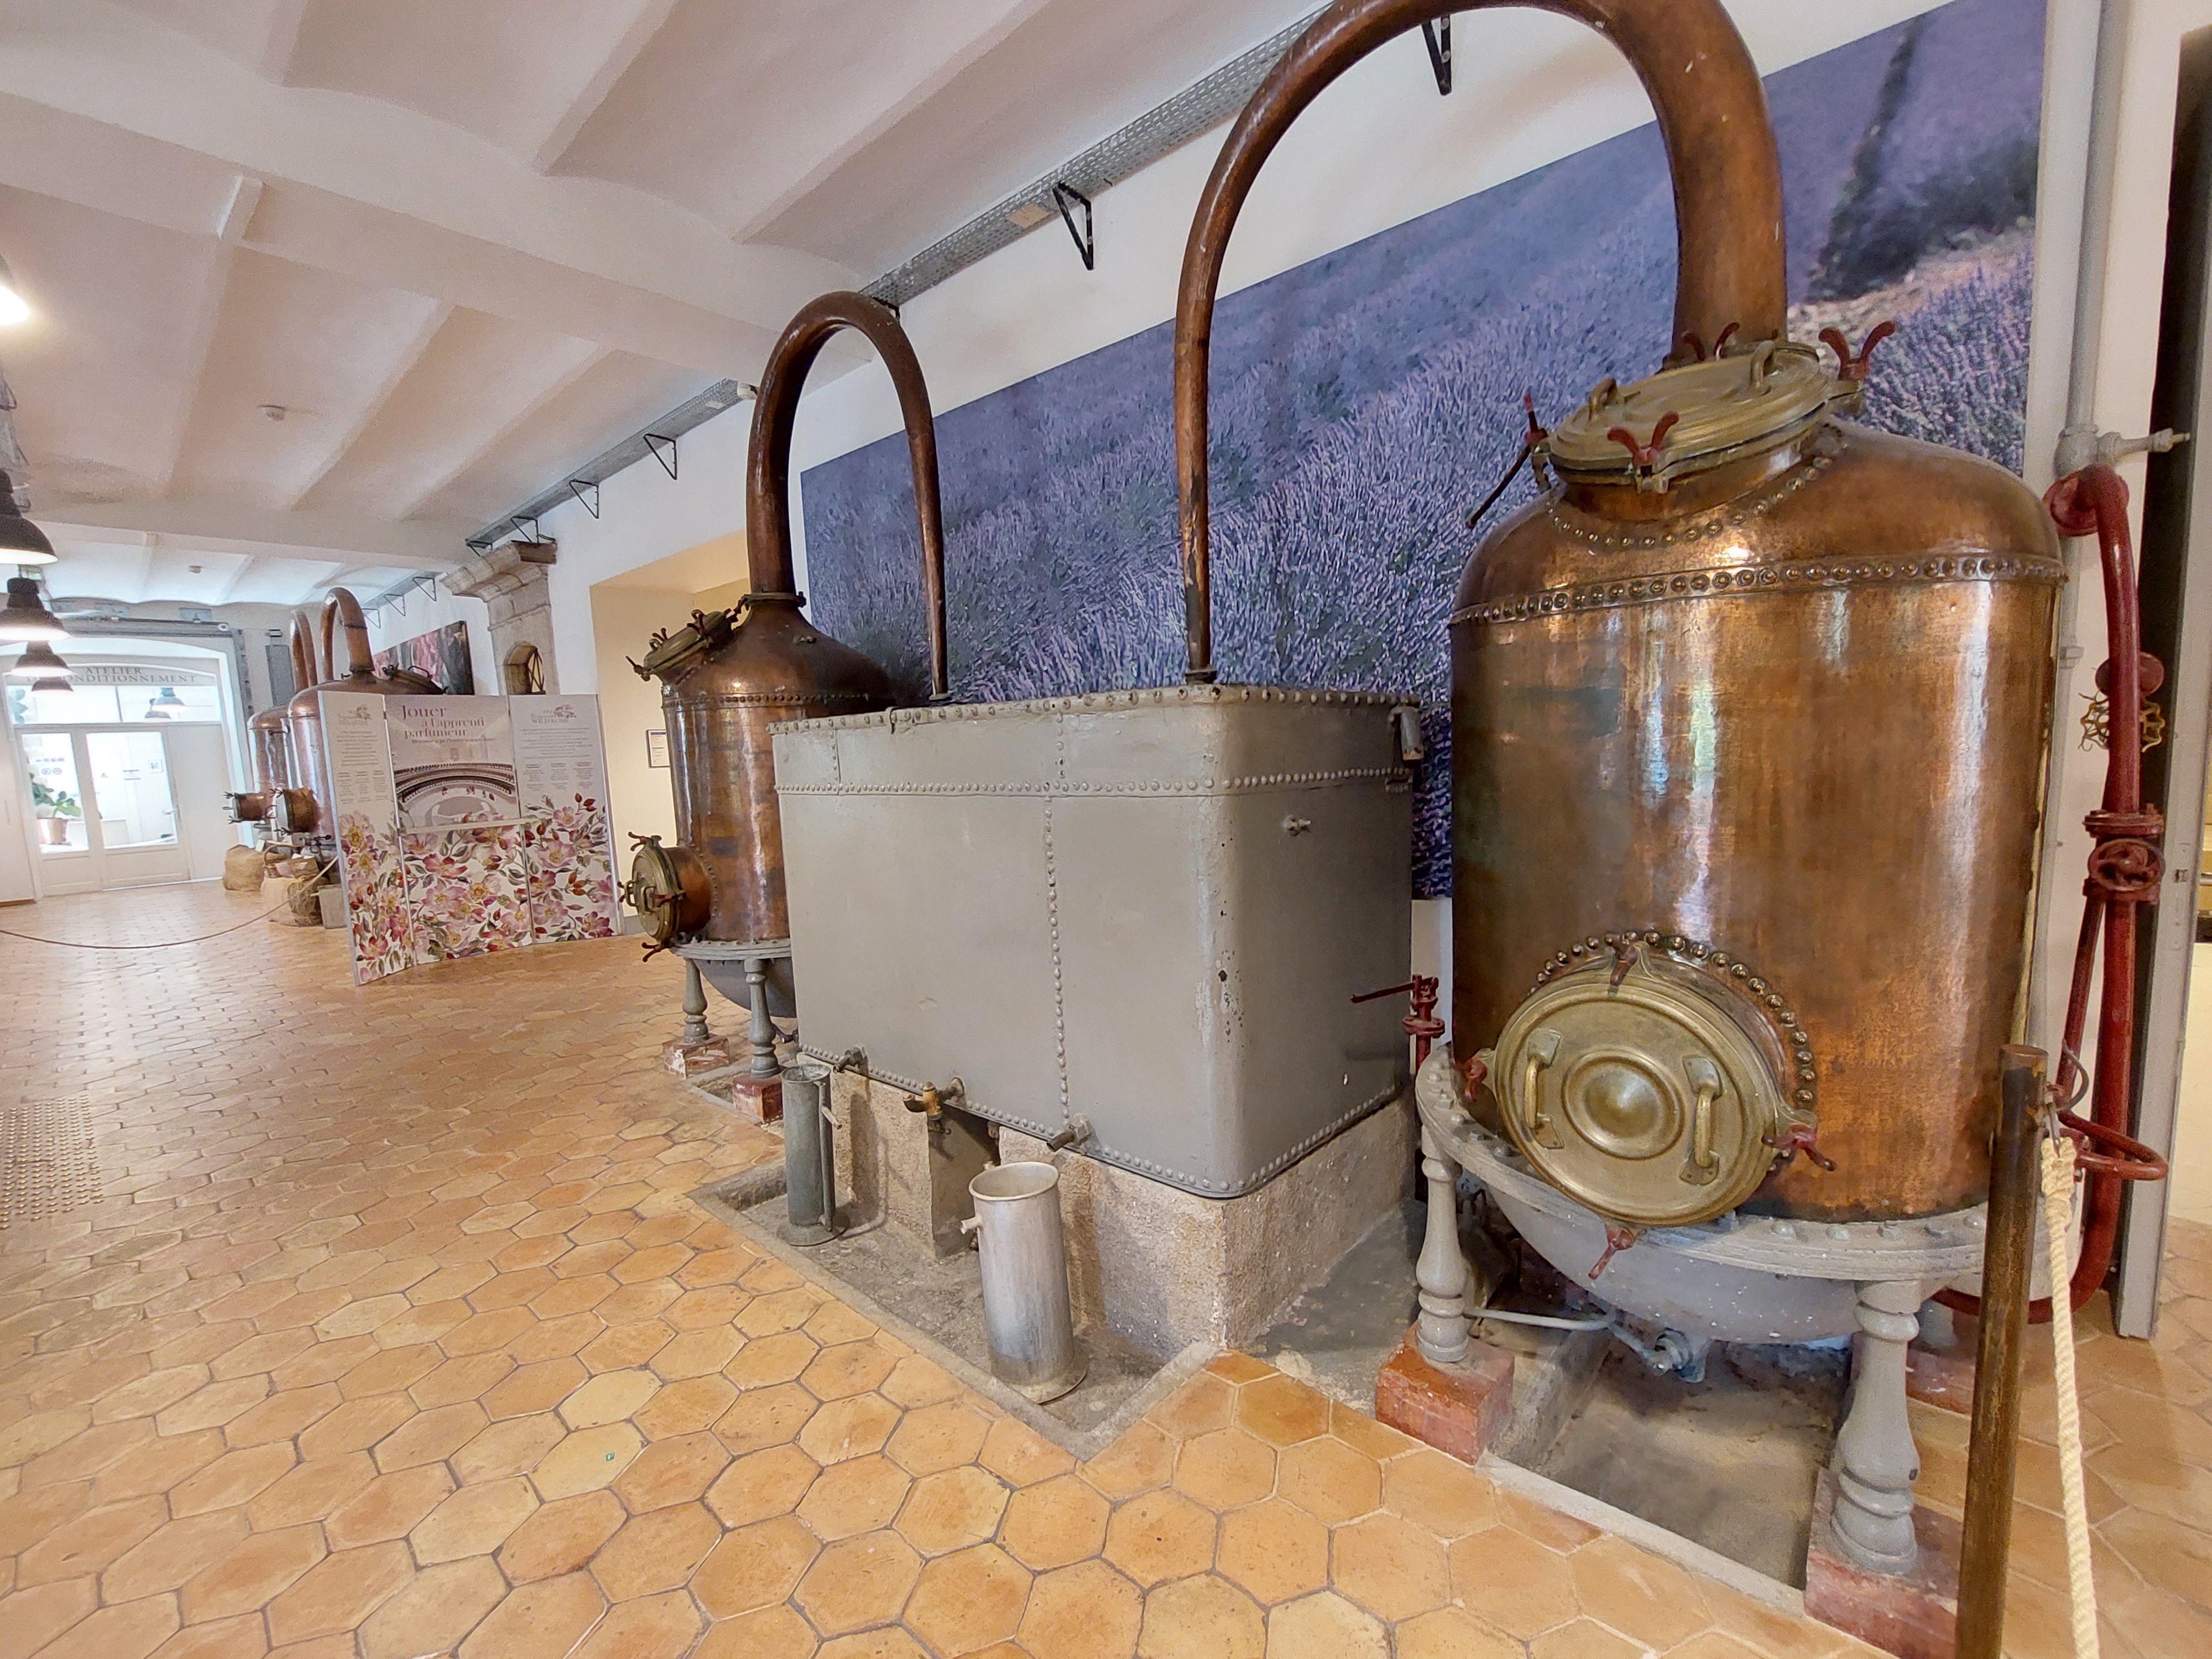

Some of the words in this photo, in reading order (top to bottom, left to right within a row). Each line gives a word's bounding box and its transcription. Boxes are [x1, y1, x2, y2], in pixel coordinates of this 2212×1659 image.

[86, 666, 142, 675] ATELIER
[63, 675, 196, 683] ONDITIONNEMENT
[402, 705, 446, 720] Jouer
[404, 728, 467, 740] parfumeur
